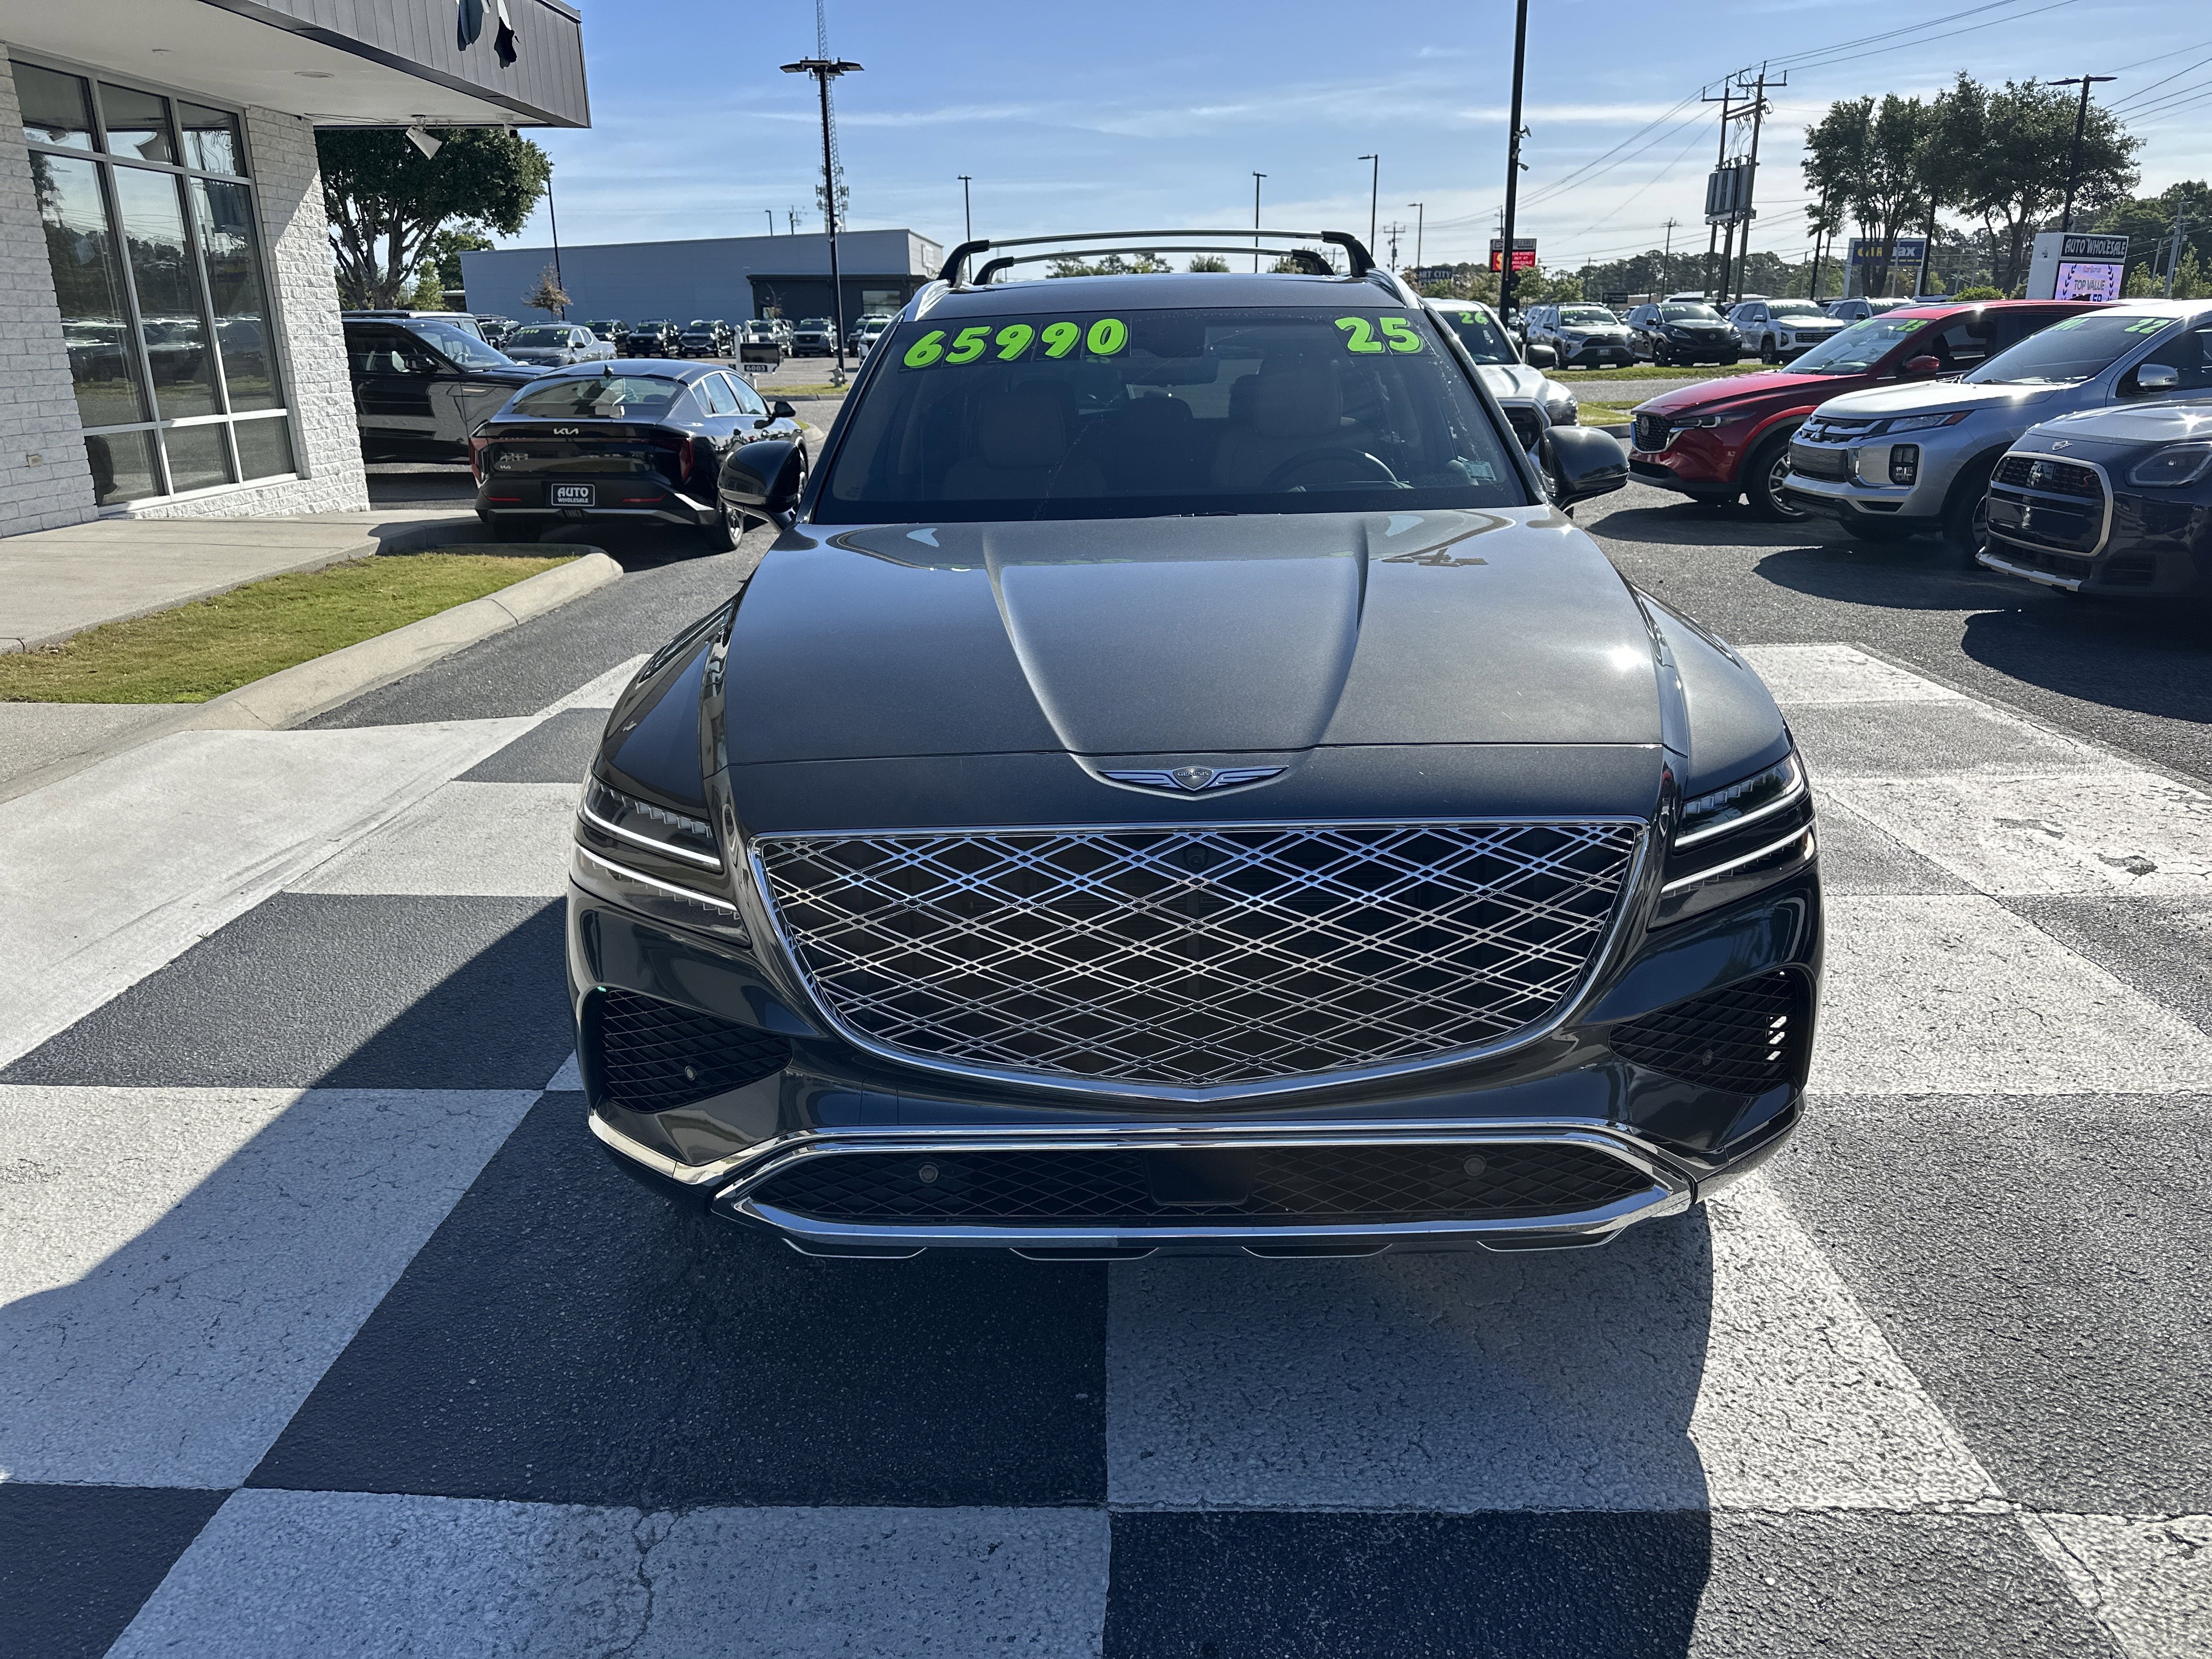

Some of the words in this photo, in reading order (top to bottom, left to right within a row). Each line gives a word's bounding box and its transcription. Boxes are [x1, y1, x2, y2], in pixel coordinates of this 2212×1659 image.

[2064, 238, 2086, 254] AUTO
[2086, 238, 2126, 256] WHOLESALE
[2074, 279, 2086, 291] TOP
[2086, 279, 2106, 291] VALUE
[1458, 312, 1489, 324] 26
[1895, 319, 1928, 332] 23
[2124, 318, 2170, 334] 22
[1334, 317, 1426, 354] 25
[904, 318, 1128, 368] 65990
[557, 487, 589, 498] AUTO
